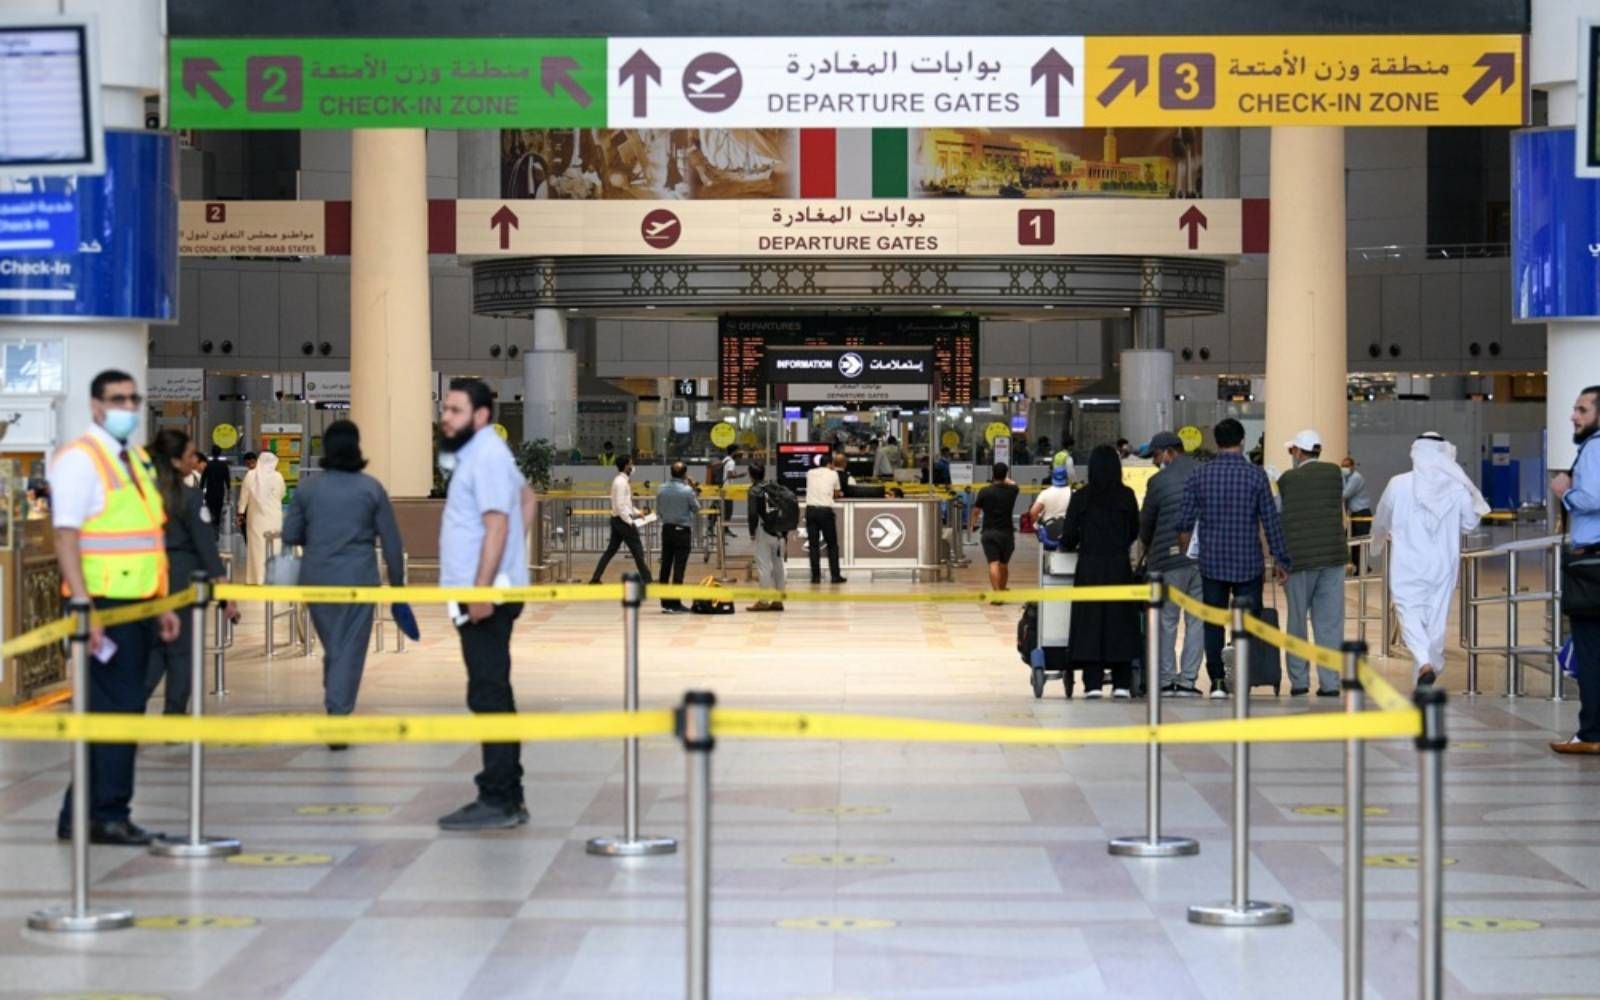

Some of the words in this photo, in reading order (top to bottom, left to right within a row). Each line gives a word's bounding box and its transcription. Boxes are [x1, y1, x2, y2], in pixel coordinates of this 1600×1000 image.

[310, 53, 388, 79] الأمتعة
[451, 60, 529, 79] منطقة
[786, 50, 897, 80] المغادرة
[910, 50, 1001, 81] بوابات
[1228, 48, 1305, 76] الأمتعة
[1314, 58, 1360, 81] وزن
[1370, 56, 1449, 76] منطقة
[261, 65, 288, 103] 2
[394, 63, 442, 84] وزن
[1175, 62, 1200, 101] 3
[319, 95, 442, 116] CHECK-IN
[451, 95, 520, 116] ZONE
[767, 93, 925, 112] DEPARTURE
[934, 93, 1020, 112] GATES
[1238, 93, 1362, 113] CHECK-IN
[1369, 92, 1440, 112] ZONE
[210, 206, 221, 220] 2
[772, 206, 851, 227] المغادرة
[860, 206, 925, 228] بوابات
[1029, 215, 1041, 240] 1
[195, 245, 227, 253] COUNCIL
[230, 245, 246, 253] FOR
[248, 245, 261, 253] THE
[265, 245, 286, 253] ARAB
[288, 245, 317, 253] STATES
[759, 236, 871, 250] DEPARTURE
[876, 236, 938, 250] GATES
[0, 259, 71, 276] Check-In
[776, 359, 833, 369] INFORMATION
